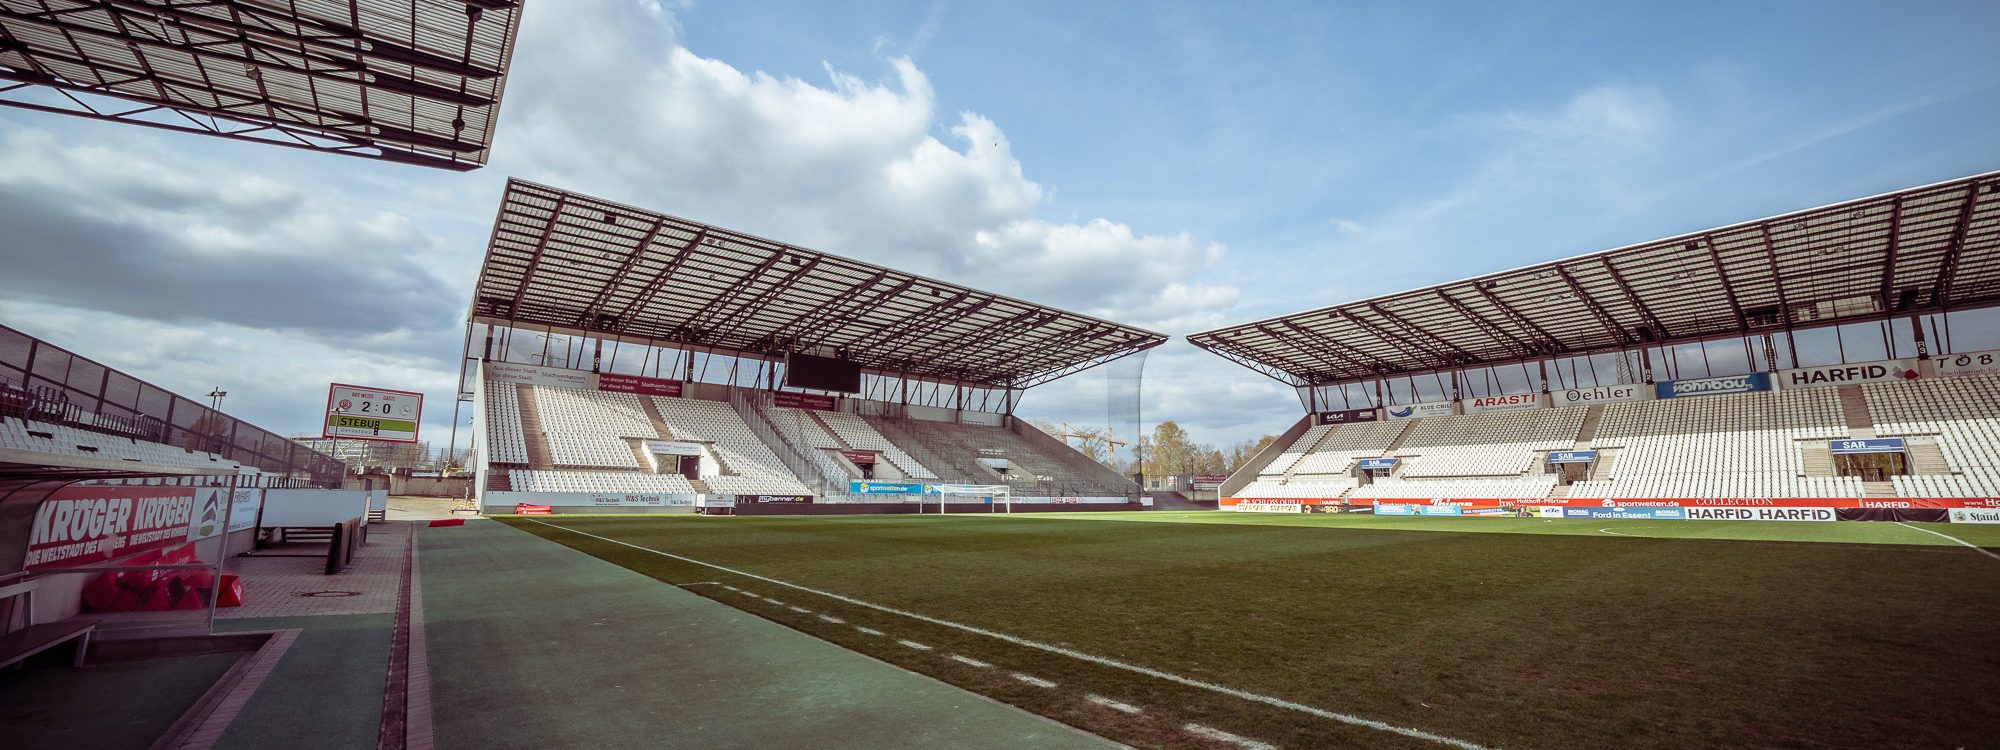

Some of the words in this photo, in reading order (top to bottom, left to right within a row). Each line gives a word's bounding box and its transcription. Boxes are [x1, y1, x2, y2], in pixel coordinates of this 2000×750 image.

[1936, 354, 2000, 368] TÖB
[1791, 365, 1887, 385] HARFID
[1473, 393, 1536, 407] ARASTI
[1566, 386, 1634, 402] Oehler
[362, 402, 370, 412] 2
[383, 404, 391, 414] 0
[340, 417, 374, 428] STEBU
[1842, 441, 1866, 449] SAR
[625, 494, 639, 502] W&S
[640, 494, 660, 502] Technik
[1695, 497, 1774, 506] COLLECTION
[1687, 508, 1753, 519] HARFID
[1759, 508, 1832, 520] HARFID
[30, 498, 132, 546] KRÖGER
[133, 496, 193, 530] KRÖGER
[40, 542, 85, 564] WELTSTADT
[85, 539, 97, 555] DES
